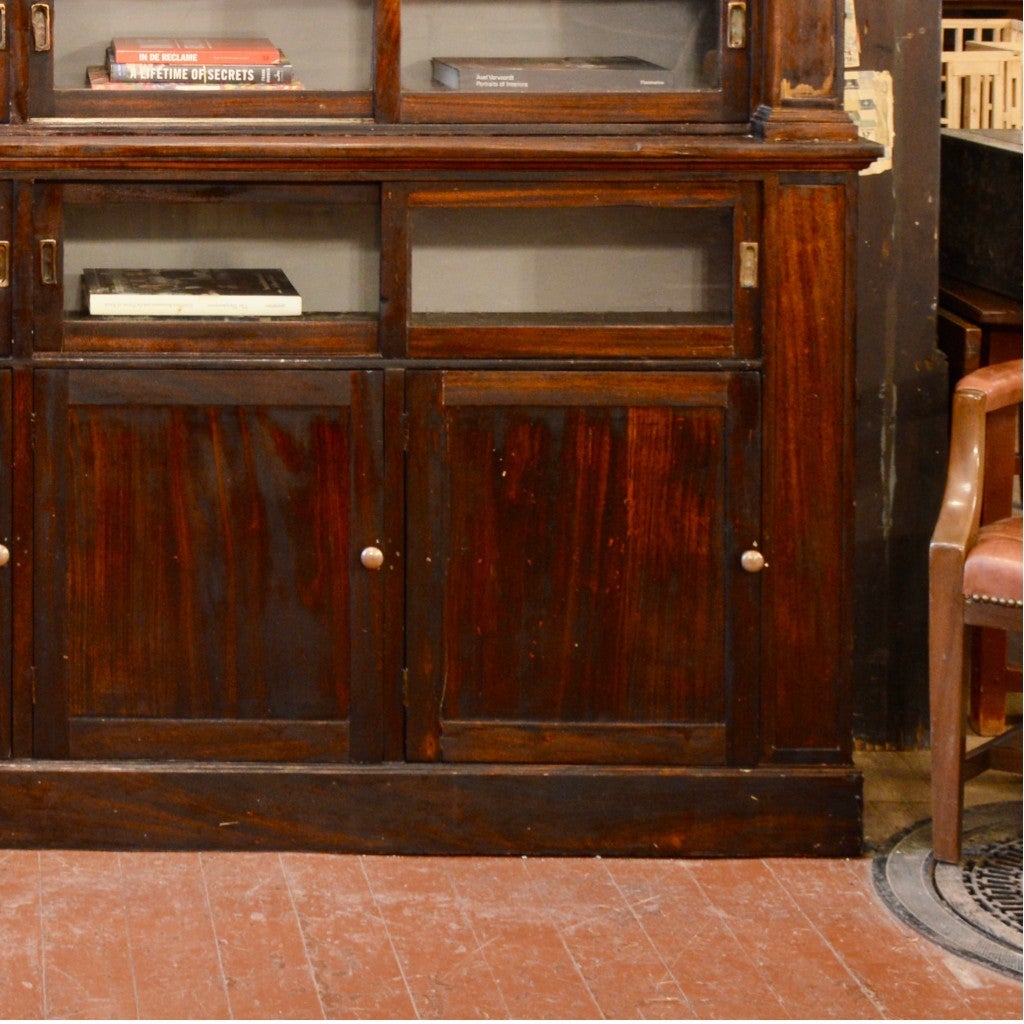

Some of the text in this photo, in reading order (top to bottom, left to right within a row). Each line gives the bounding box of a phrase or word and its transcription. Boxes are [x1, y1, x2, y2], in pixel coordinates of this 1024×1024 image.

[139, 53, 198, 62] IN DE RECLAME
[140, 67, 188, 80] LIFETIME
[191, 68, 204, 80] OF
[208, 68, 254, 81] SECRETS
